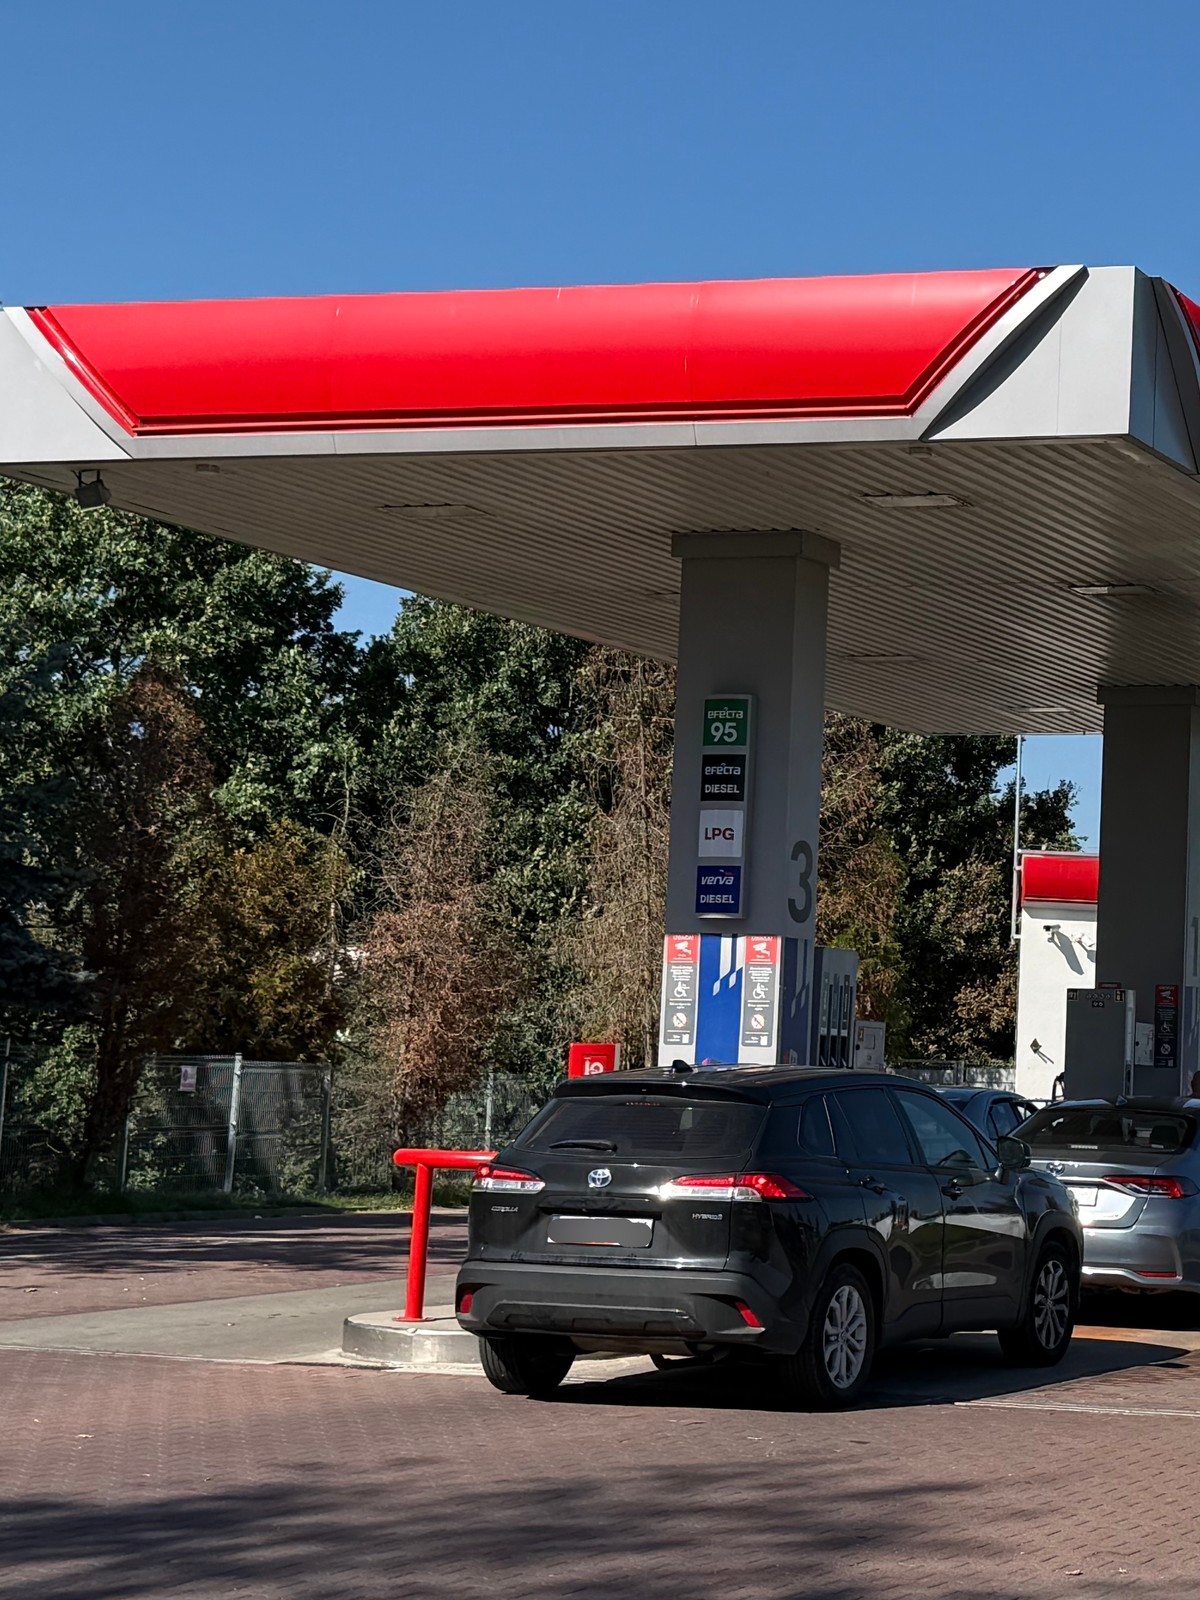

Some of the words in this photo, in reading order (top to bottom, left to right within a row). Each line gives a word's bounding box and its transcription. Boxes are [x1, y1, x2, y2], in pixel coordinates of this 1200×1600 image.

[710, 721, 738, 743] 95
[704, 784, 740, 794] DIESEL
[704, 827, 735, 841] LPG
[700, 874, 735, 885] verva
[787, 839, 814, 924] 3
[699, 894, 735, 904] DIESEL
